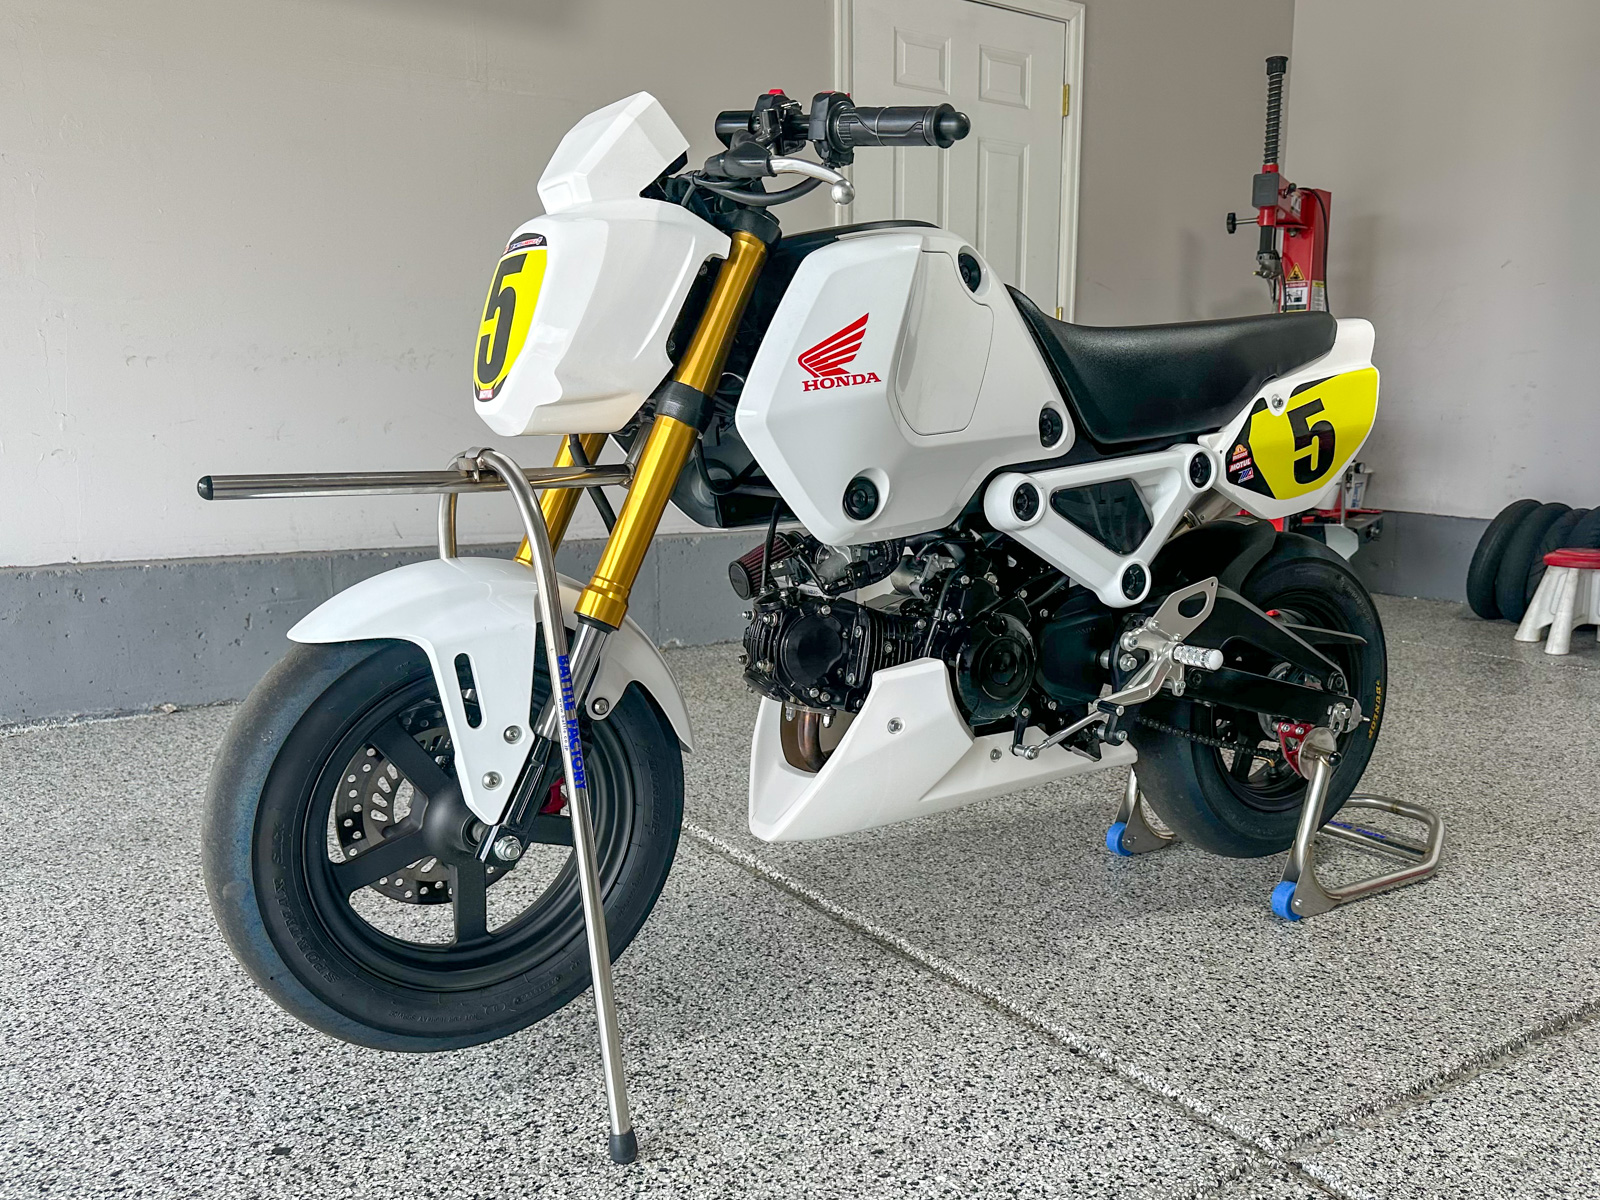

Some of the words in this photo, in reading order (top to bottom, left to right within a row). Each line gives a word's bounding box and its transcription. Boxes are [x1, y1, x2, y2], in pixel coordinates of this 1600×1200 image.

[477, 253, 528, 384] 5
[802, 372, 881, 392] HONDA
[1229, 458, 1252, 473] MOTUL
[1287, 397, 1336, 485] 5
[558, 655, 575, 711] BATTLE
[567, 719, 587, 789] FACTORY
[1368, 690, 1383, 739] DUNLOP
[273, 877, 340, 984] SPORTMAX
